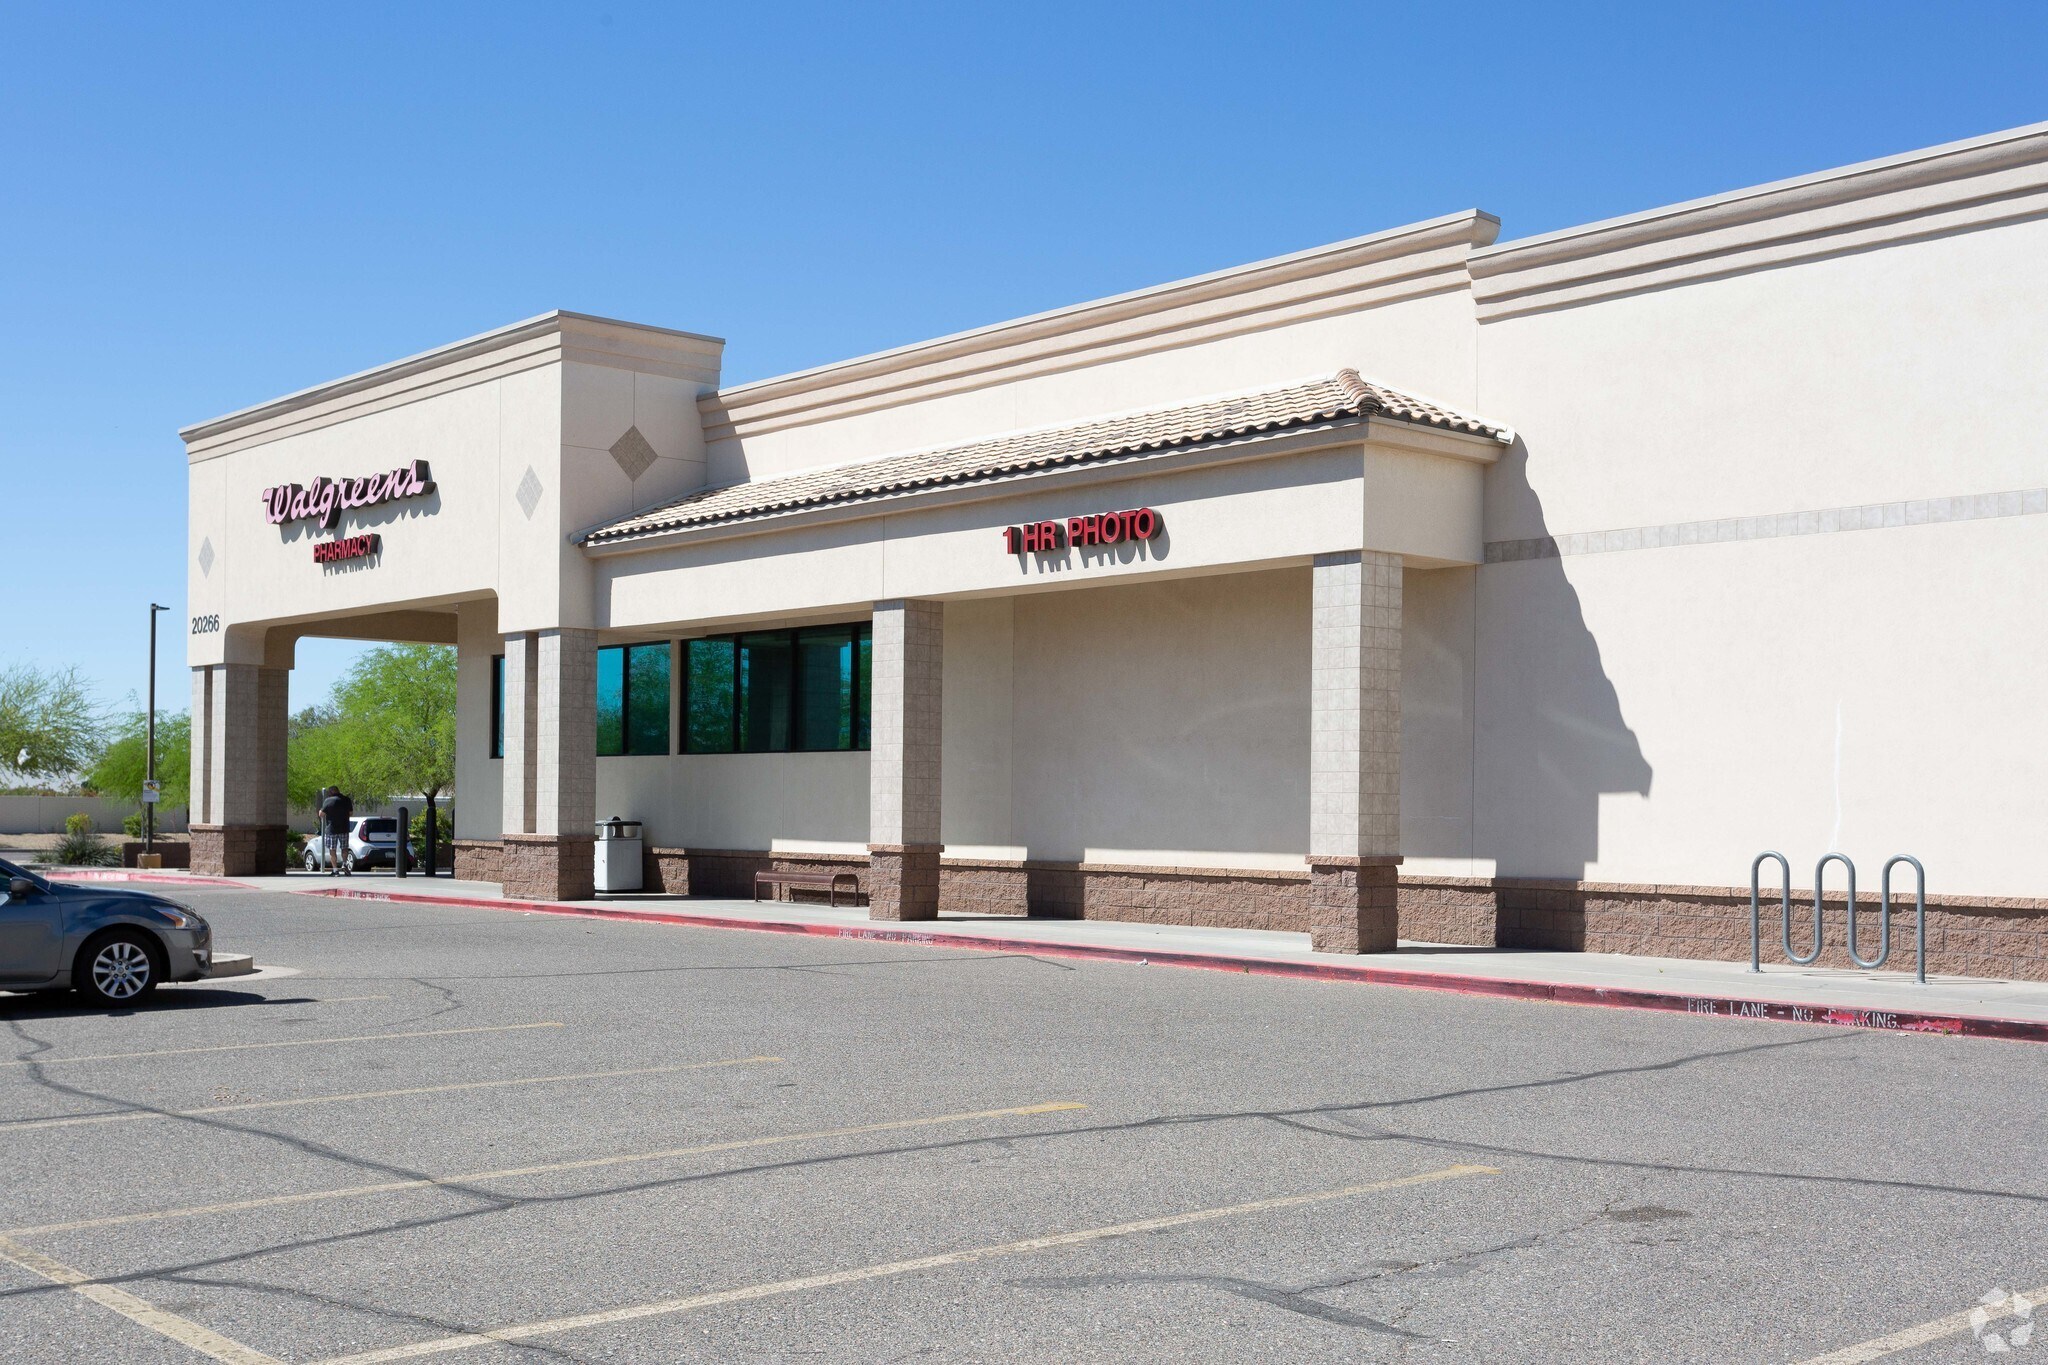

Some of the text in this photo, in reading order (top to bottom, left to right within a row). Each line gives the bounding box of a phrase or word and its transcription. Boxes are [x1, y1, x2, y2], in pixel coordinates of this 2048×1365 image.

[262, 459, 434, 529] Walgreens
[1003, 507, 1160, 554] 1 HR PHOTO
[313, 533, 378, 563] PHARMACY
[192, 614, 220, 635] 20266
[857, 930, 876, 940] LANE
[1687, 998, 1718, 1016] FIRE
[1729, 1001, 1770, 1019] LANE
[1792, 1006, 1814, 1022] NO
[1827, 1009, 1900, 1029] PKING
